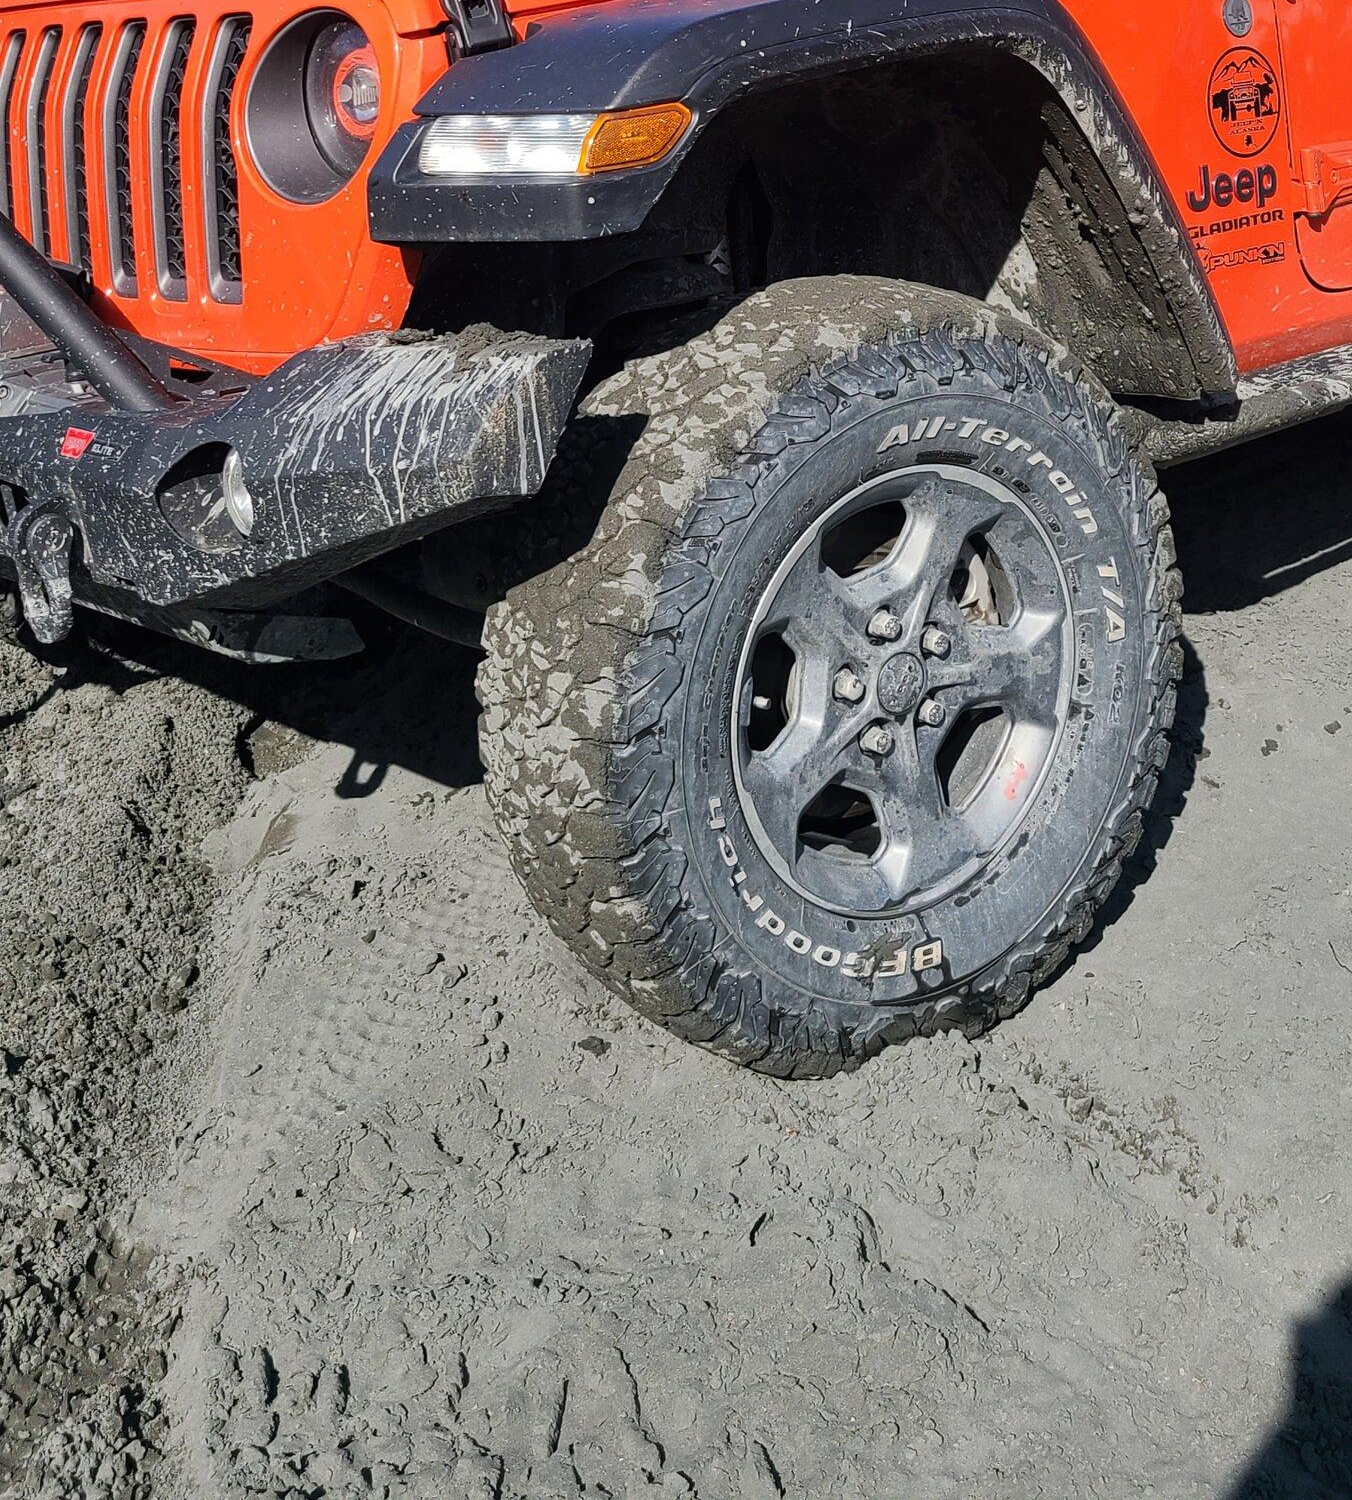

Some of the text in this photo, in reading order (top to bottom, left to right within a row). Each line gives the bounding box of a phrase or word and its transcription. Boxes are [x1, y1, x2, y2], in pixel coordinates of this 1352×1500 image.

[1186, 164, 1277, 213] Jeep
[1187, 209, 1284, 239] GLADIATOR
[877, 416, 1098, 534] All-Terrain
[1097, 556, 1126, 643] T/A
[707, 796, 944, 978] BFGoodrich
